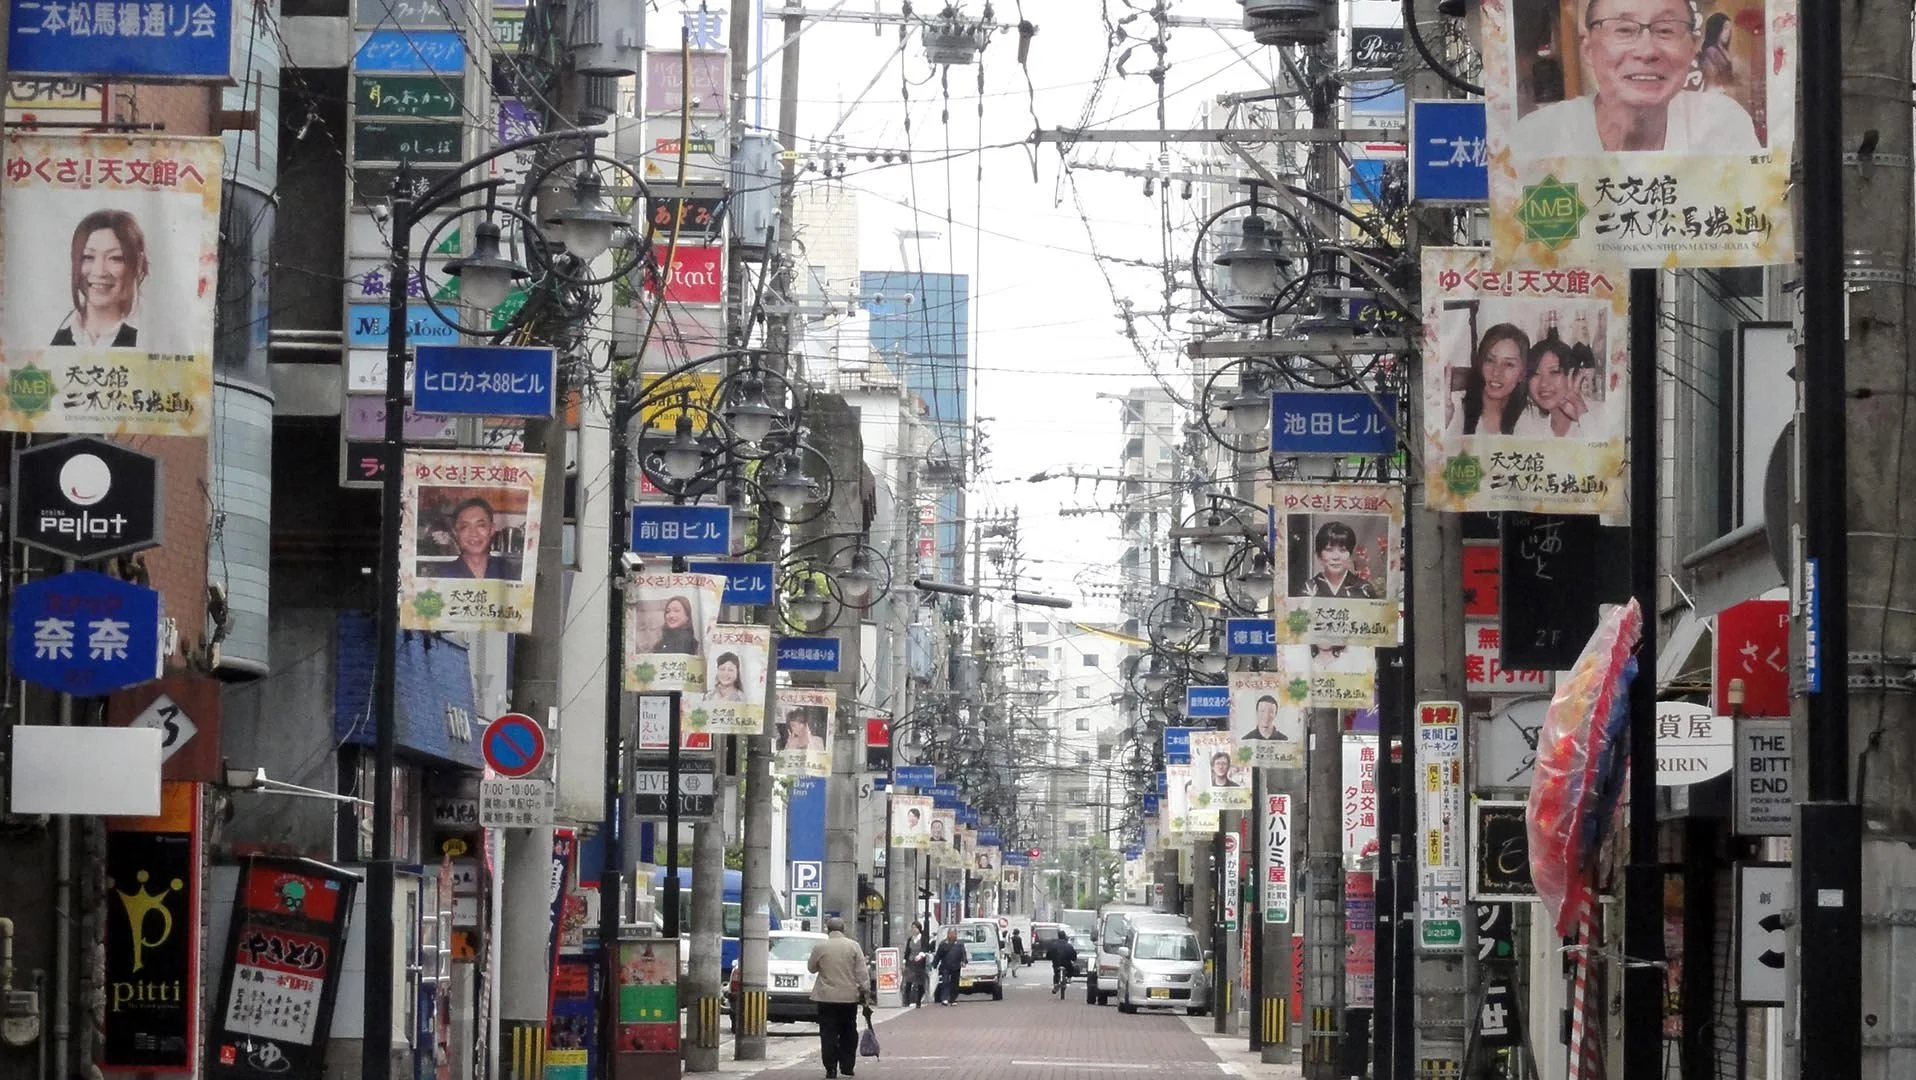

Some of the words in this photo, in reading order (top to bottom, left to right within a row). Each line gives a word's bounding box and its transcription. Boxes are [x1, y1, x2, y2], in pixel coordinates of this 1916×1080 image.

[17, 2, 217, 38] 二本松馬場通り会
[678, 4, 728, 49] 東
[1594, 175, 1677, 206] 天文館
[64, 366, 129, 388] 天文館
[424, 370, 545, 394] ヒロカネ88ビル
[1283, 412, 1386, 436] 池田ビル
[1489, 452, 1545, 473] 天文館
[640, 521, 721, 540] 前田ビル
[1750, 736, 1785, 751] THE
[1360, 747, 1375, 828] 鹿児島交通
[1750, 778, 1788, 793] END
[1345, 786, 1359, 849] タクシー
[1267, 796, 1288, 882] 質ハルミ屋
[112, 980, 182, 1012] pitti
